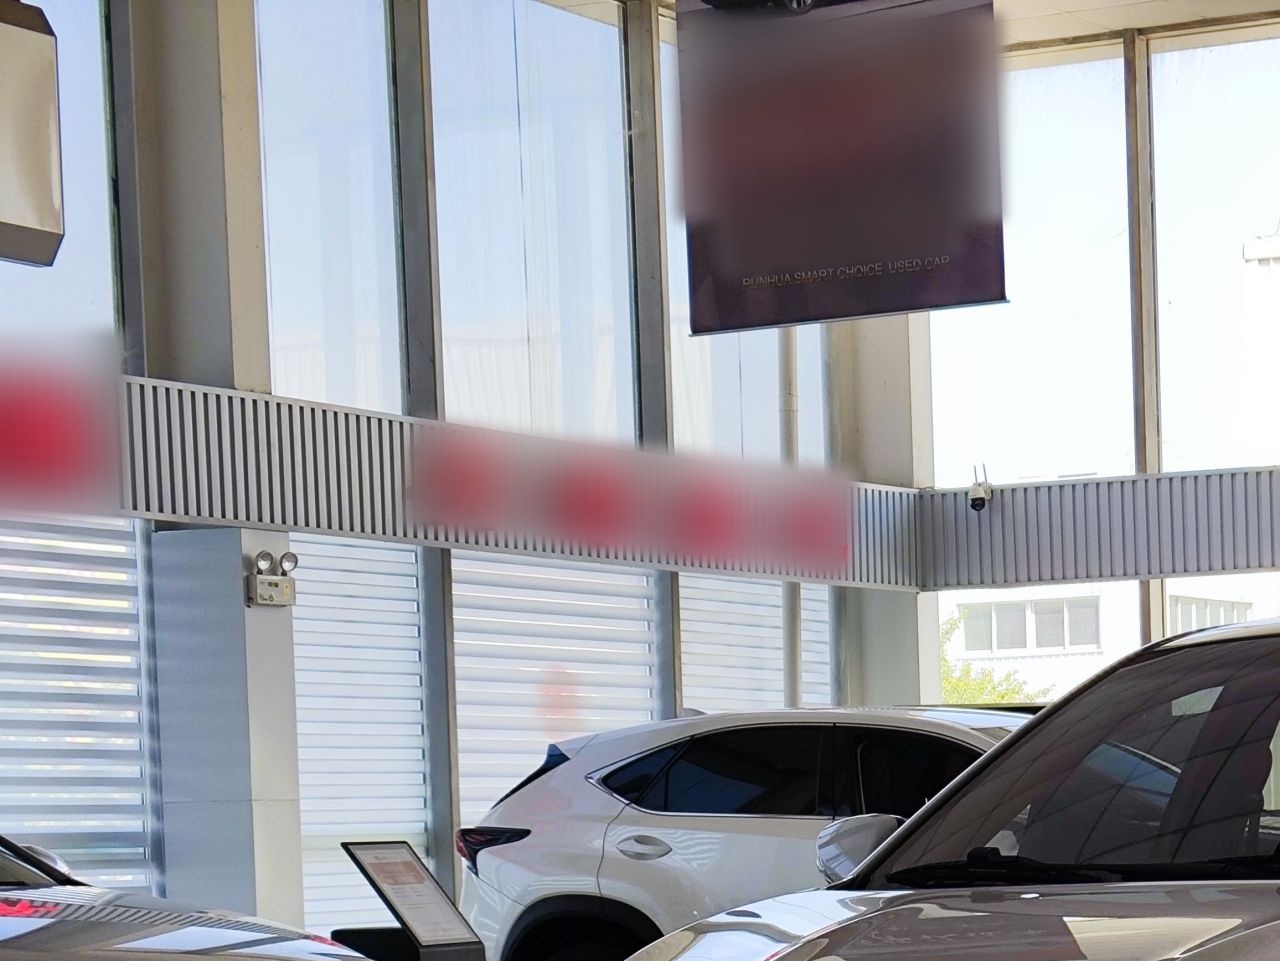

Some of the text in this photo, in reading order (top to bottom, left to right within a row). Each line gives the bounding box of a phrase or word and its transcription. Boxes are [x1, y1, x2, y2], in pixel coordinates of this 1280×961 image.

[742, 255, 950, 288] RUNHUA SMART CHOICE USED CAR
